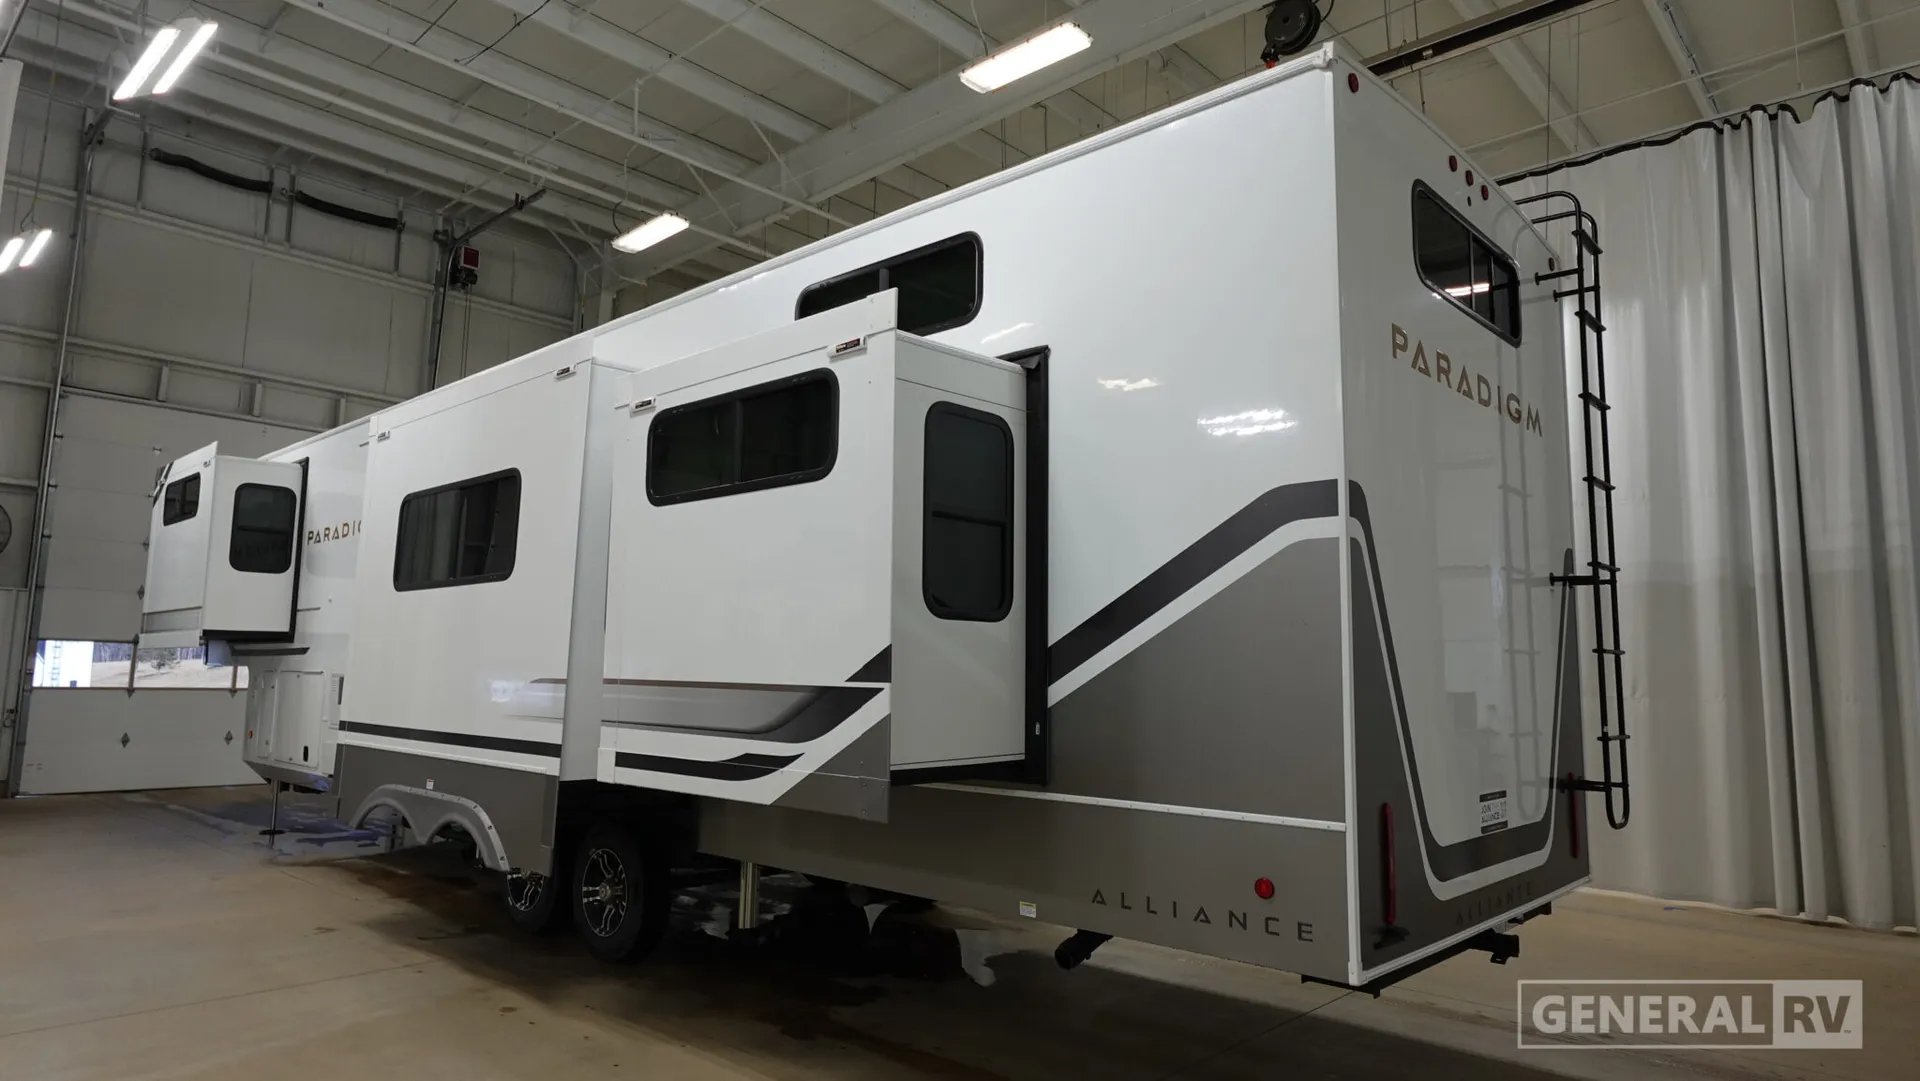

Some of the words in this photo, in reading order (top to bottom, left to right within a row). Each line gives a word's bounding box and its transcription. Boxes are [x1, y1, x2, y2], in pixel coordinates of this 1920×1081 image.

[1391, 322, 1543, 437] PARADIGM
[1091, 888, 1314, 943] ALLIANCE
[1456, 882, 1532, 925] ALLIANCE
